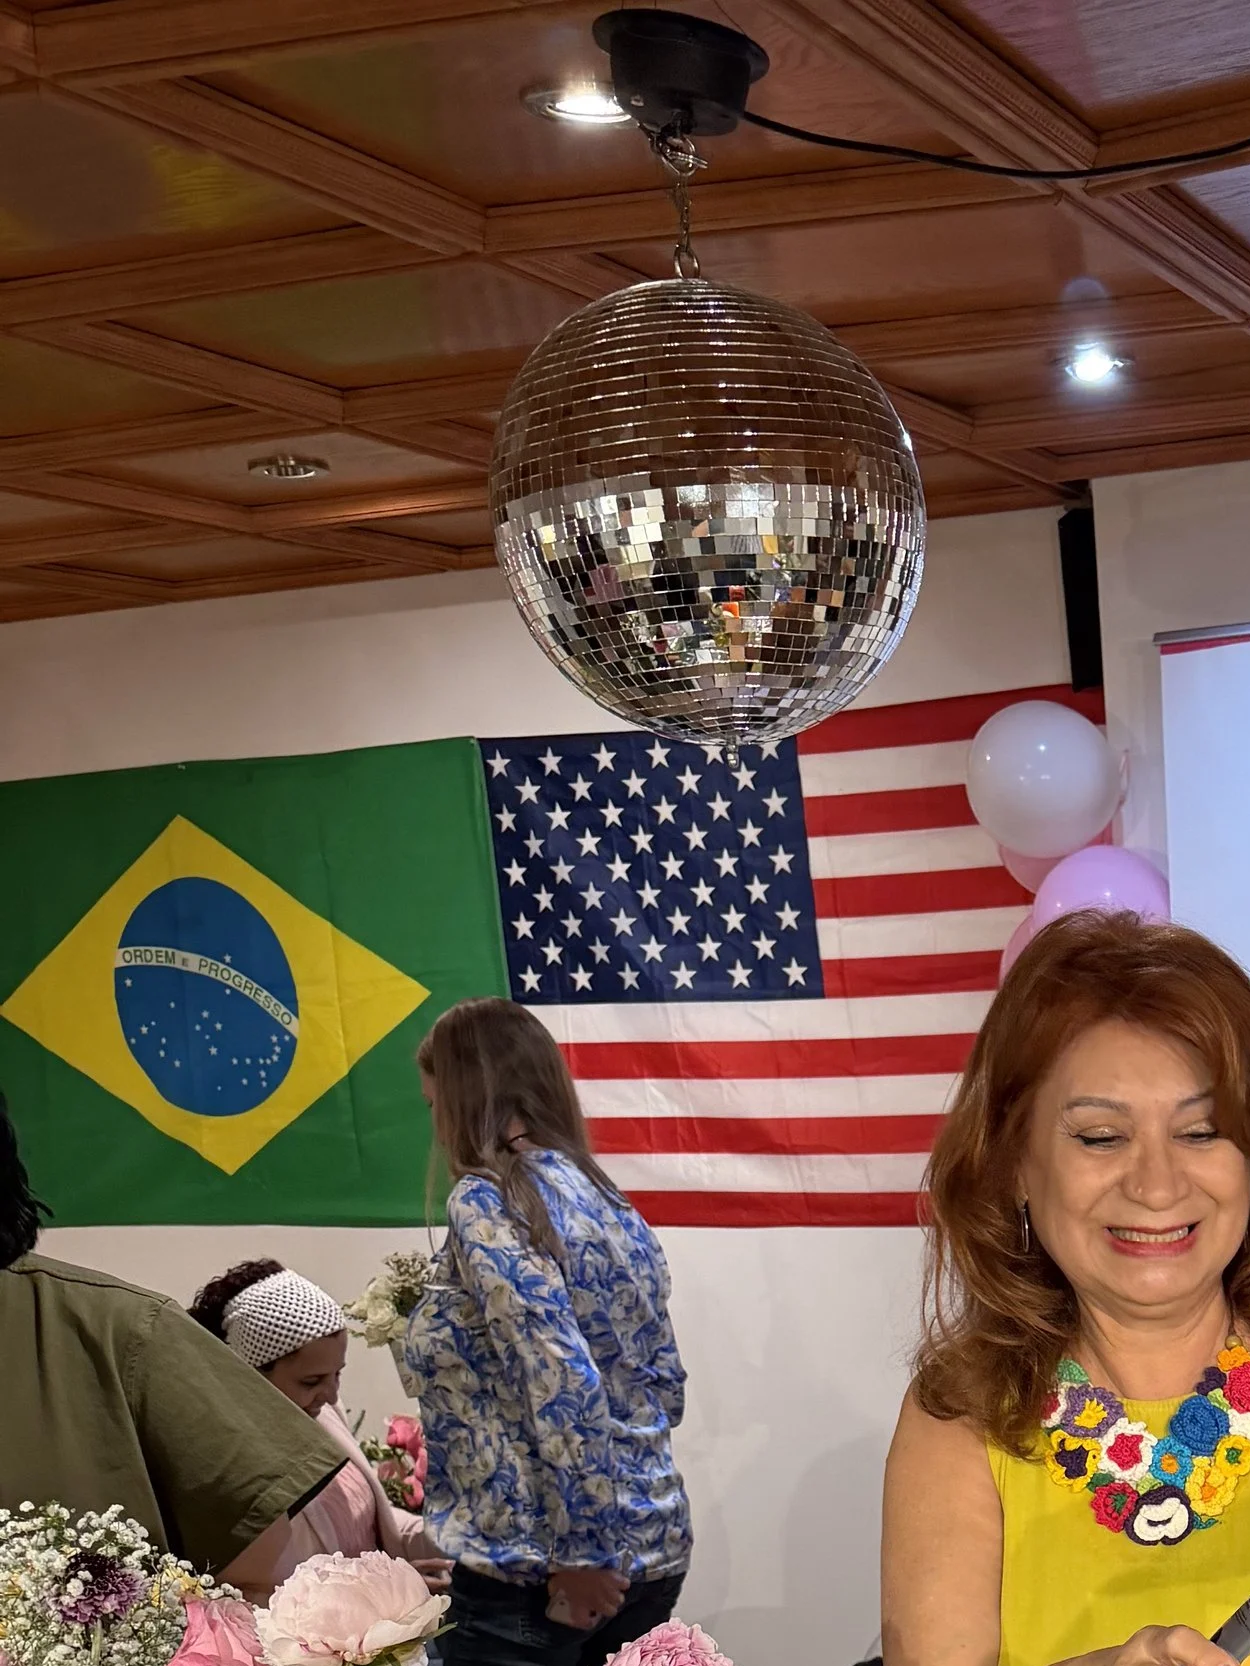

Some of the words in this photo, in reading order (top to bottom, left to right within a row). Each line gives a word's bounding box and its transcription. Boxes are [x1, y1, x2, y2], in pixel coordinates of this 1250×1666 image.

[122, 949, 176, 964] ORDEM
[181, 957, 189, 967] E
[198, 958, 293, 1027] PROGRESSO
